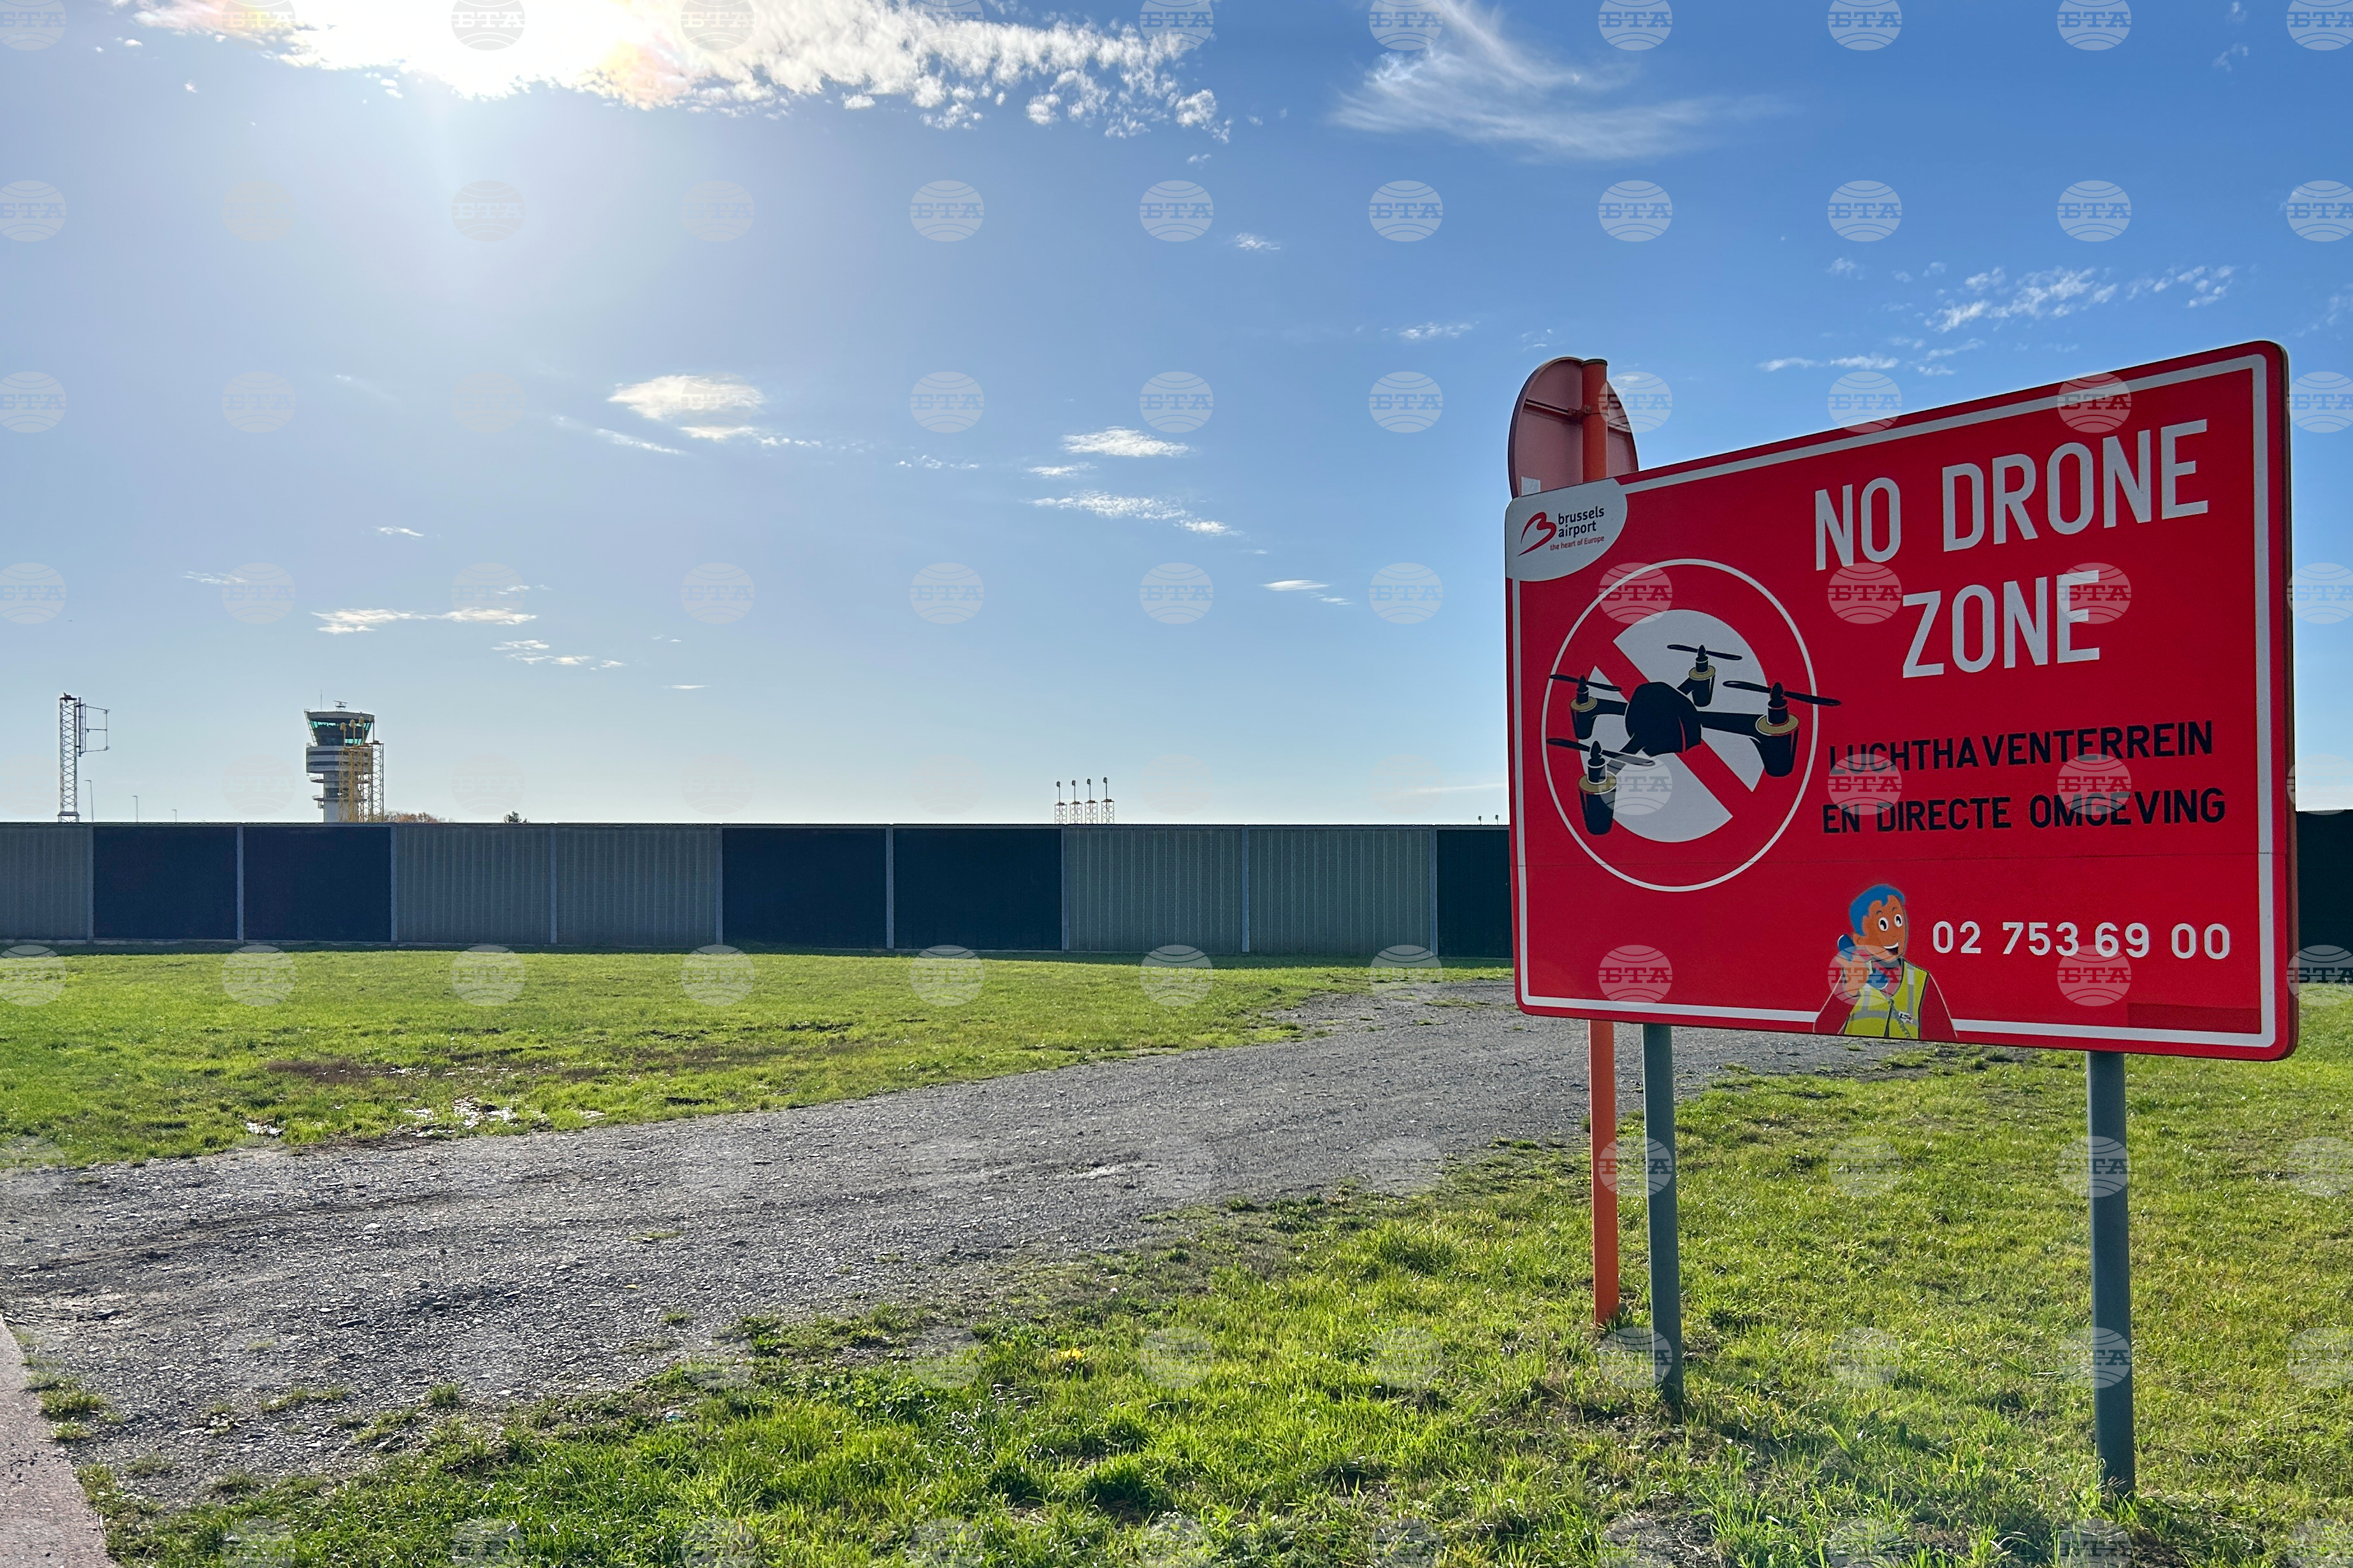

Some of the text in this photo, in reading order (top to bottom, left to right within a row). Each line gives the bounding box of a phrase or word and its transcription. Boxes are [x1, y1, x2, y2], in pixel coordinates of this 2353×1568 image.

[1558, 505, 1605, 525] brussels
[1815, 419, 2209, 571] NO DRONE
[1558, 520, 1597, 538] airport
[1560, 540, 1576, 549] heart
[1577, 538, 1583, 546] of
[1584, 536, 1605, 545] Europe
[1902, 570, 2100, 679] ZONE
[1829, 720, 2213, 775] LUCHTHAVENTERREIN
[1822, 787, 2226, 834] EN DIRECTE OMGEVING
[1932, 920, 2231, 960] 02 753 69 00
